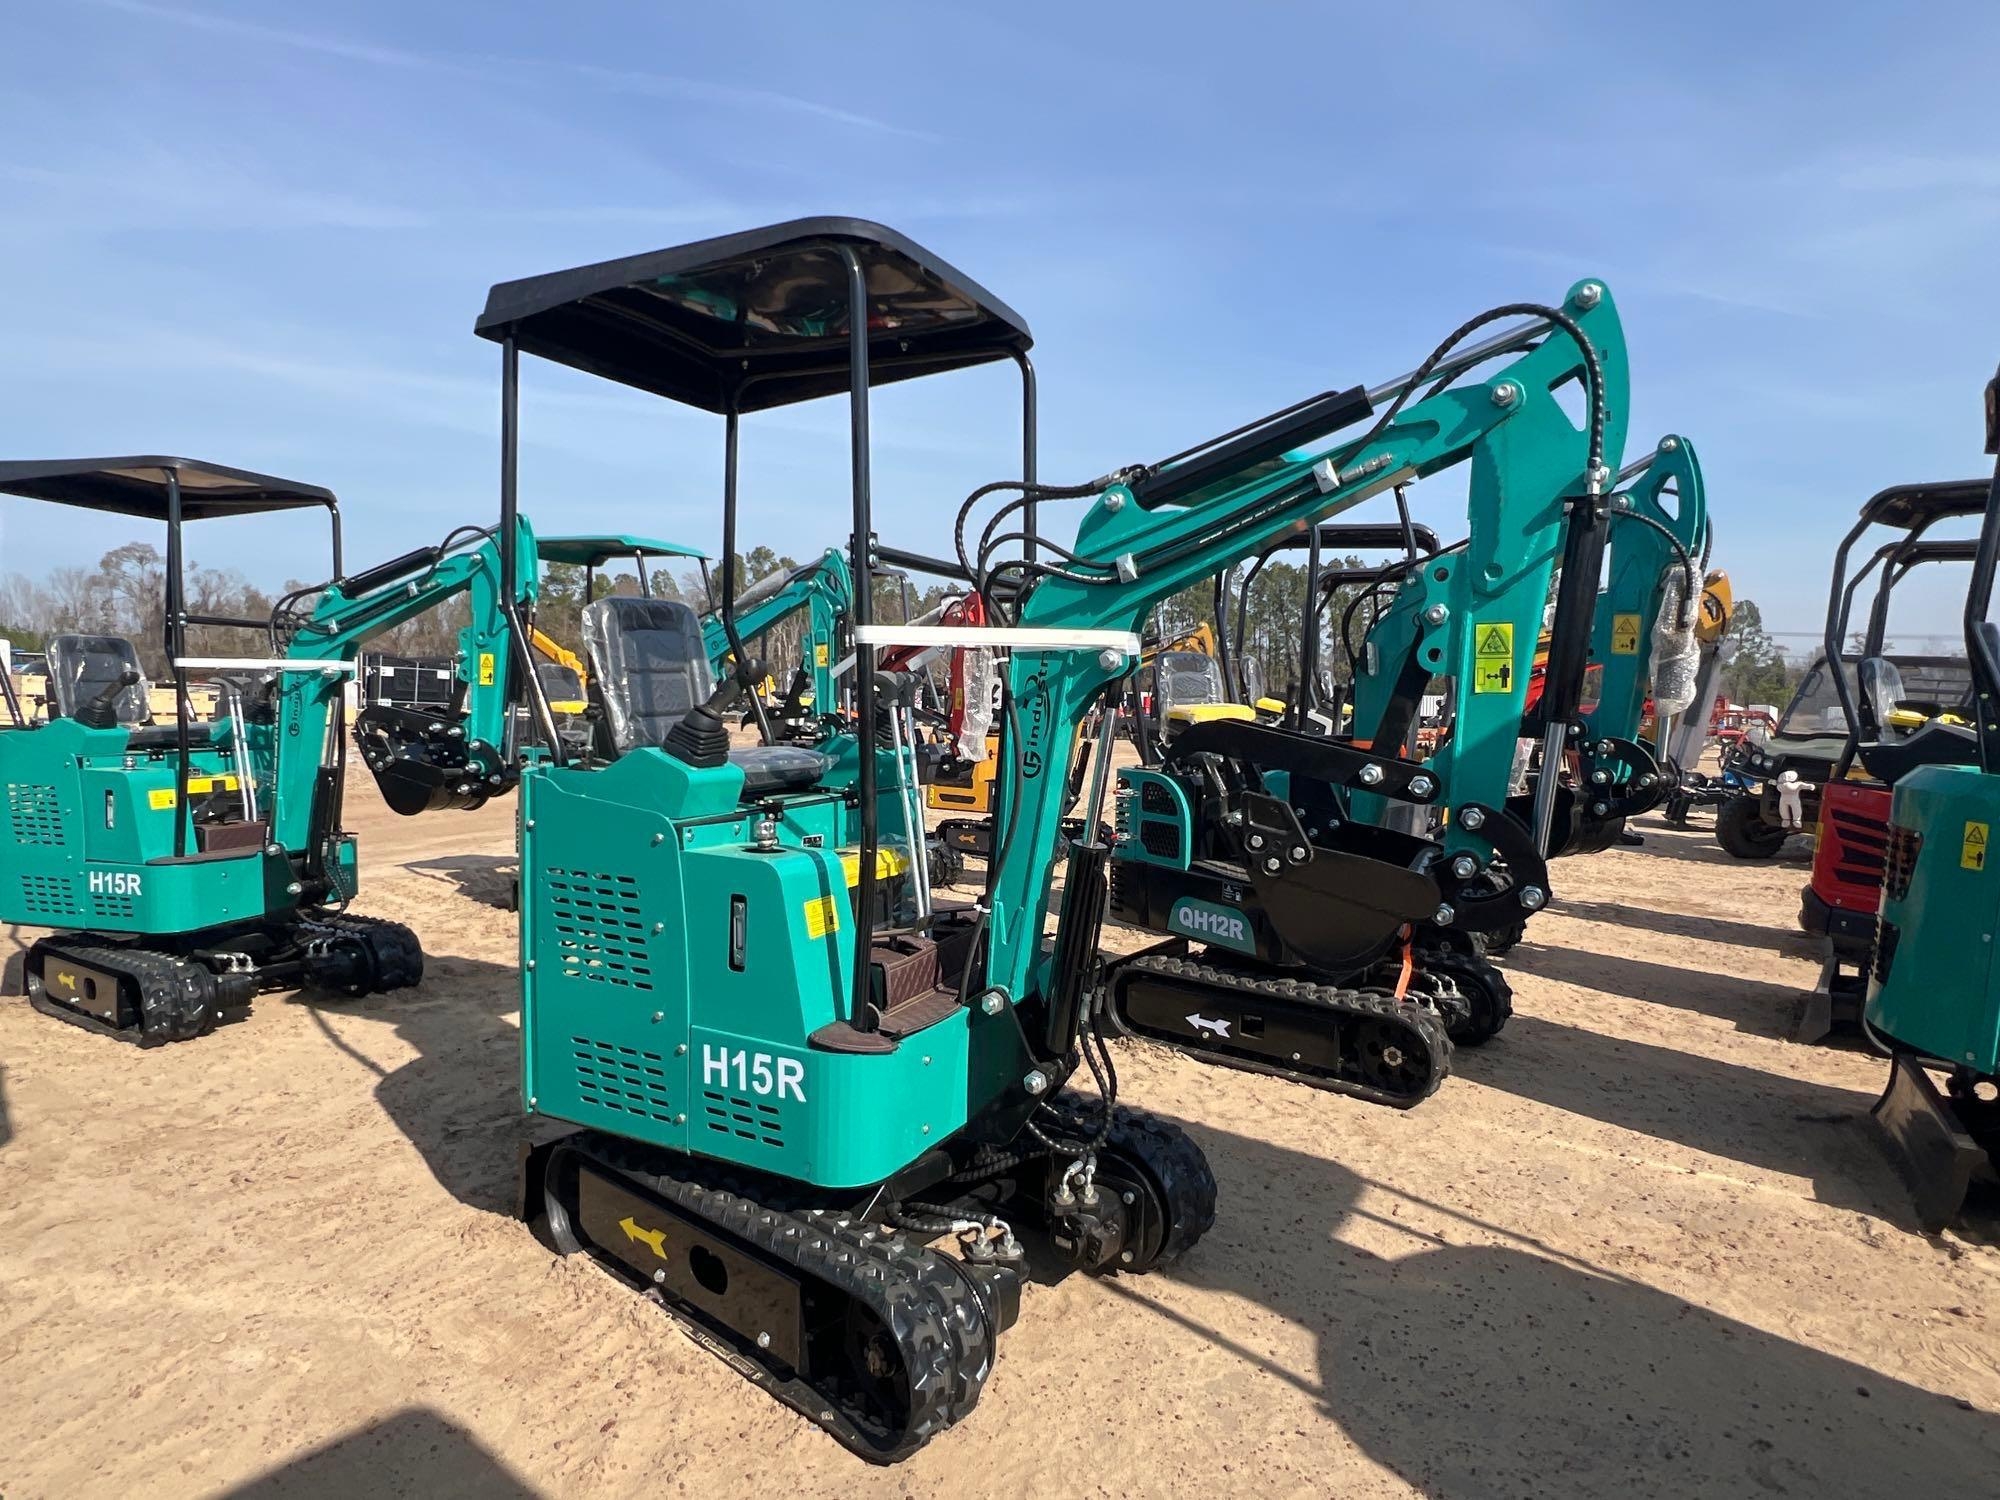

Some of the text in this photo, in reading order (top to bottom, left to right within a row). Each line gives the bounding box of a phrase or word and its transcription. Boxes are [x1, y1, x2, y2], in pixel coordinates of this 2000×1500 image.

[89, 871, 142, 896] H15R
[1179, 906, 1244, 941] QH12R
[703, 1044, 807, 1103] H15R
